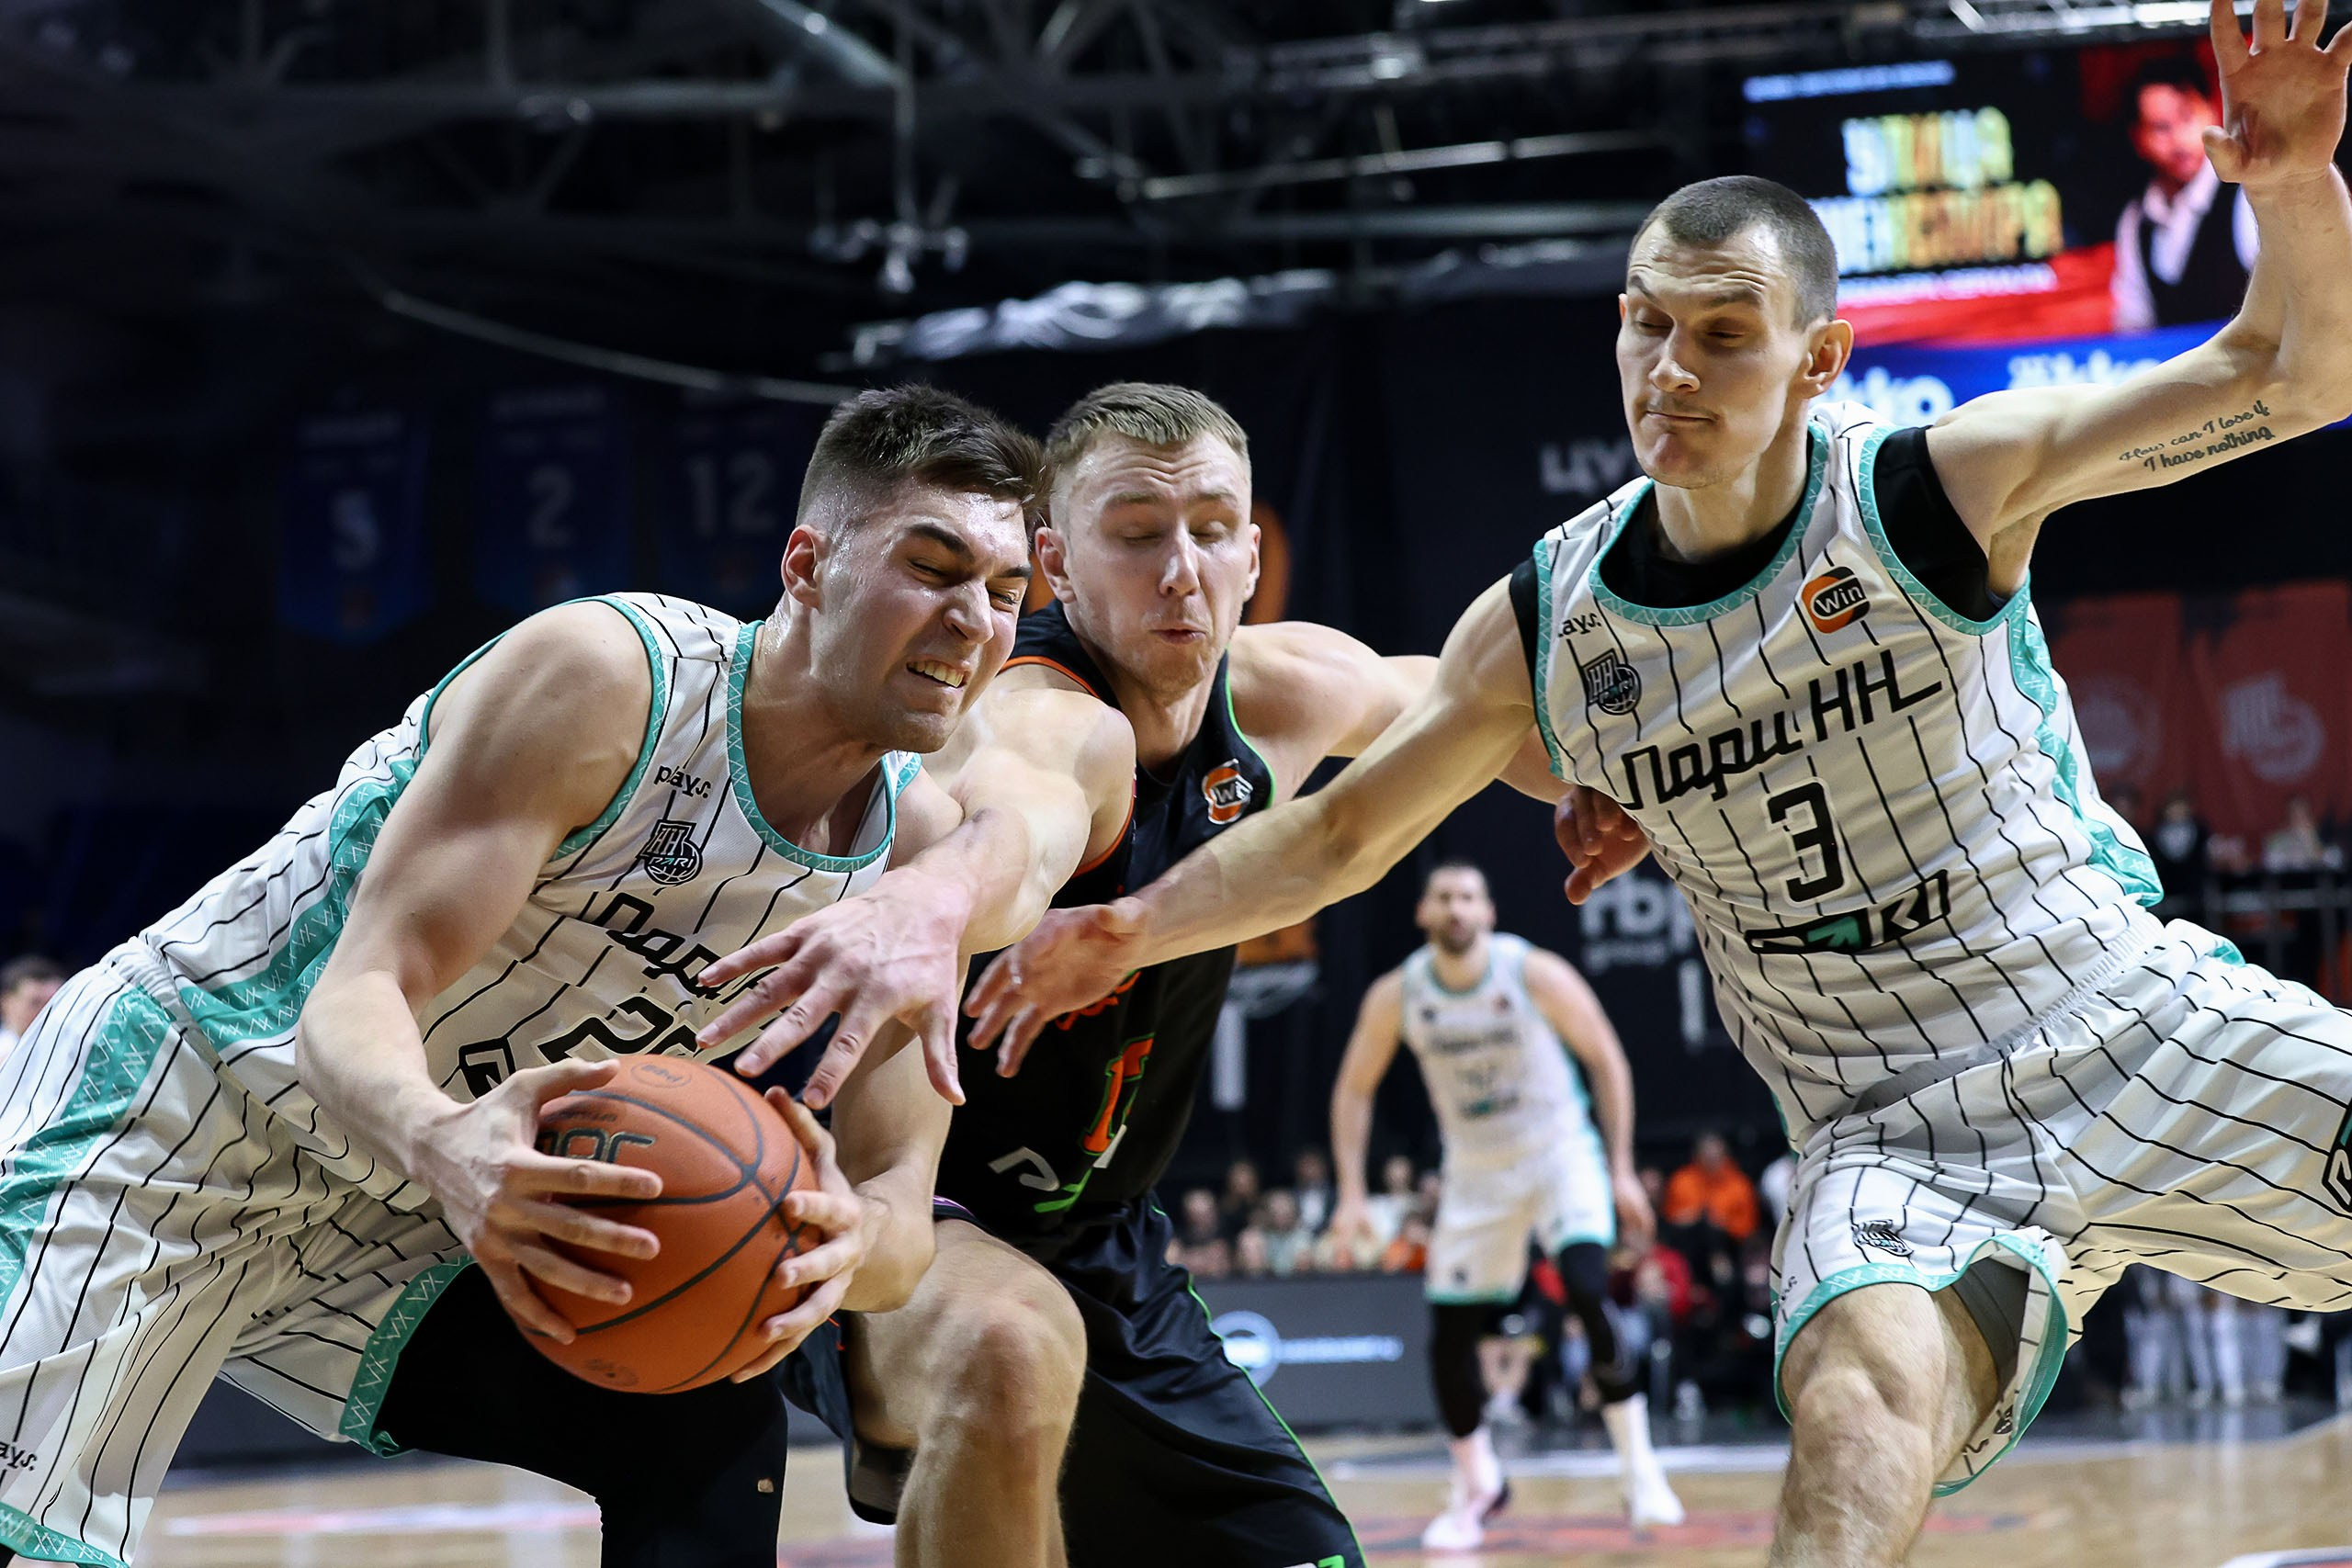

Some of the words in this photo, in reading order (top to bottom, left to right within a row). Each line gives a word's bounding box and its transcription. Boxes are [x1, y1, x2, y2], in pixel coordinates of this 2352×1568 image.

[2143, 456, 2156, 472] I
[2160, 449, 2205, 468] have
[2207, 426, 2276, 456] nothing
[2171, 431, 2202, 446] can
[2203, 421, 2215, 434] I
[2219, 412, 2254, 429] lose
[526, 465, 576, 549] 2
[1815, 586, 1863, 614] Win
[1766, 781, 1846, 904] 3
